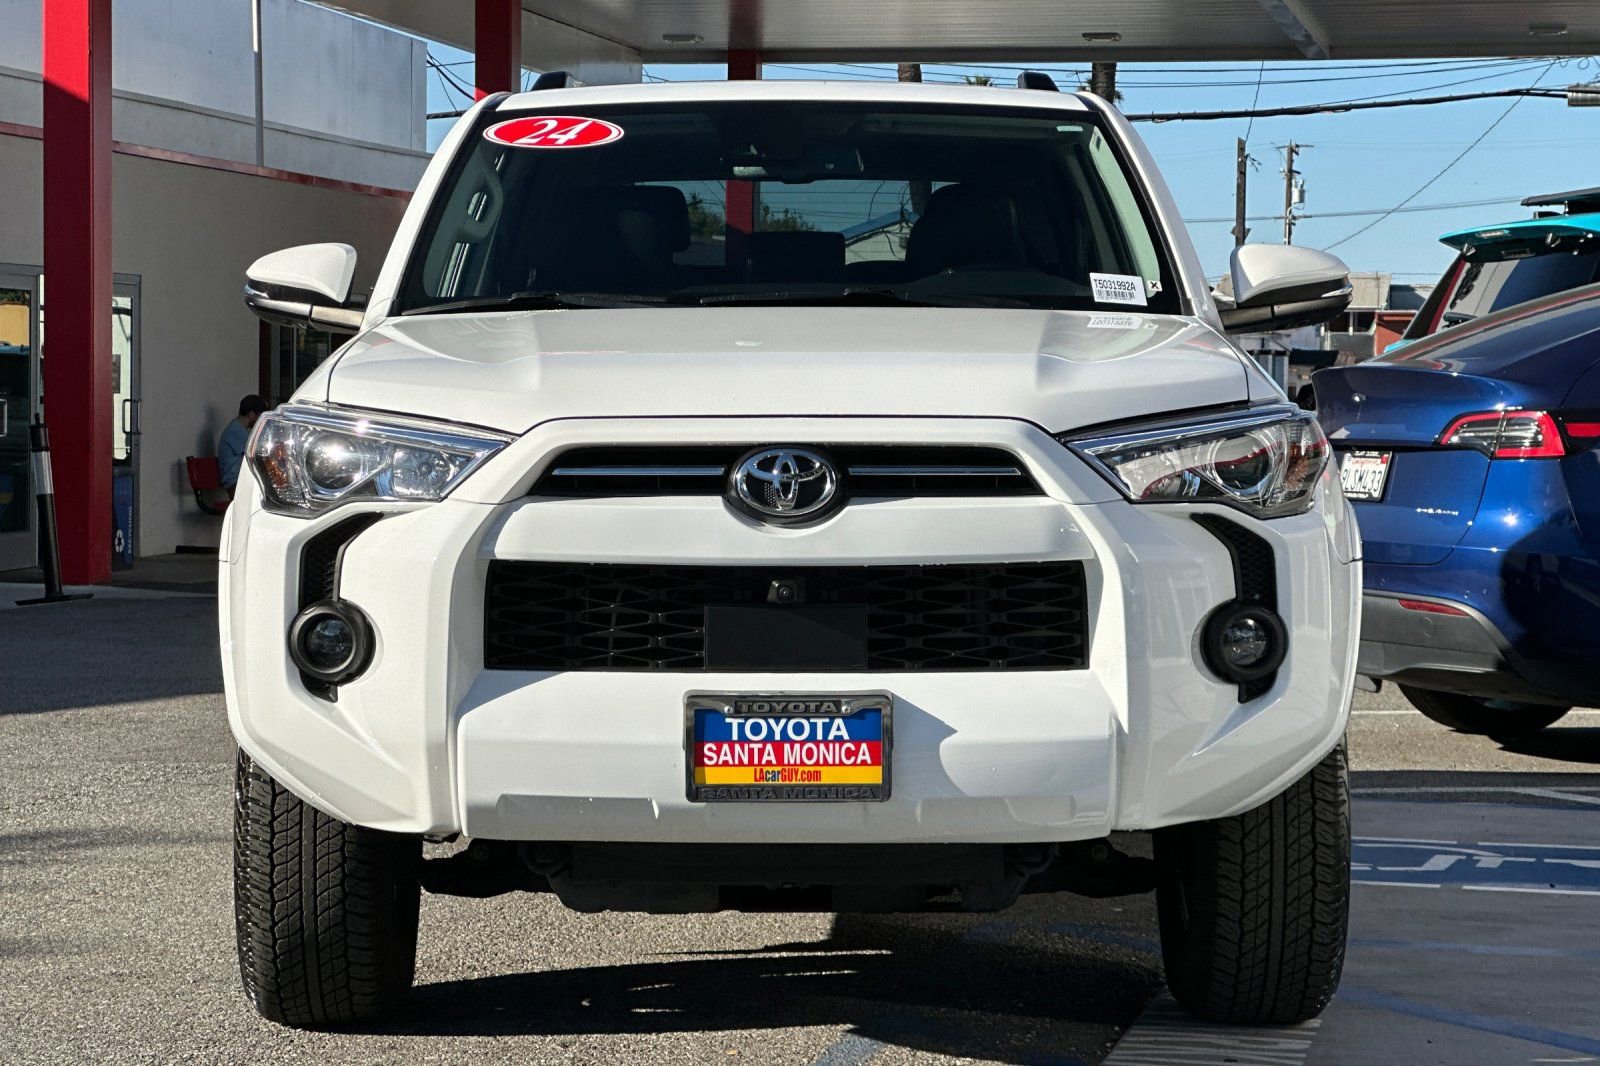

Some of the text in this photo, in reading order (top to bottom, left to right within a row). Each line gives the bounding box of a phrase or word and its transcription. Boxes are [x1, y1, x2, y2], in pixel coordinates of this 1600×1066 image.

[511, 119, 594, 145] 24
[1093, 279, 1136, 291] T5031992A
[737, 701, 837, 714] TOYOTA
[725, 717, 850, 742] TOYOTA
[703, 742, 872, 766] SANTA MONICA
[753, 767, 822, 783] LAcarGUY.com
[702, 787, 875, 800] SANTA MONICA
